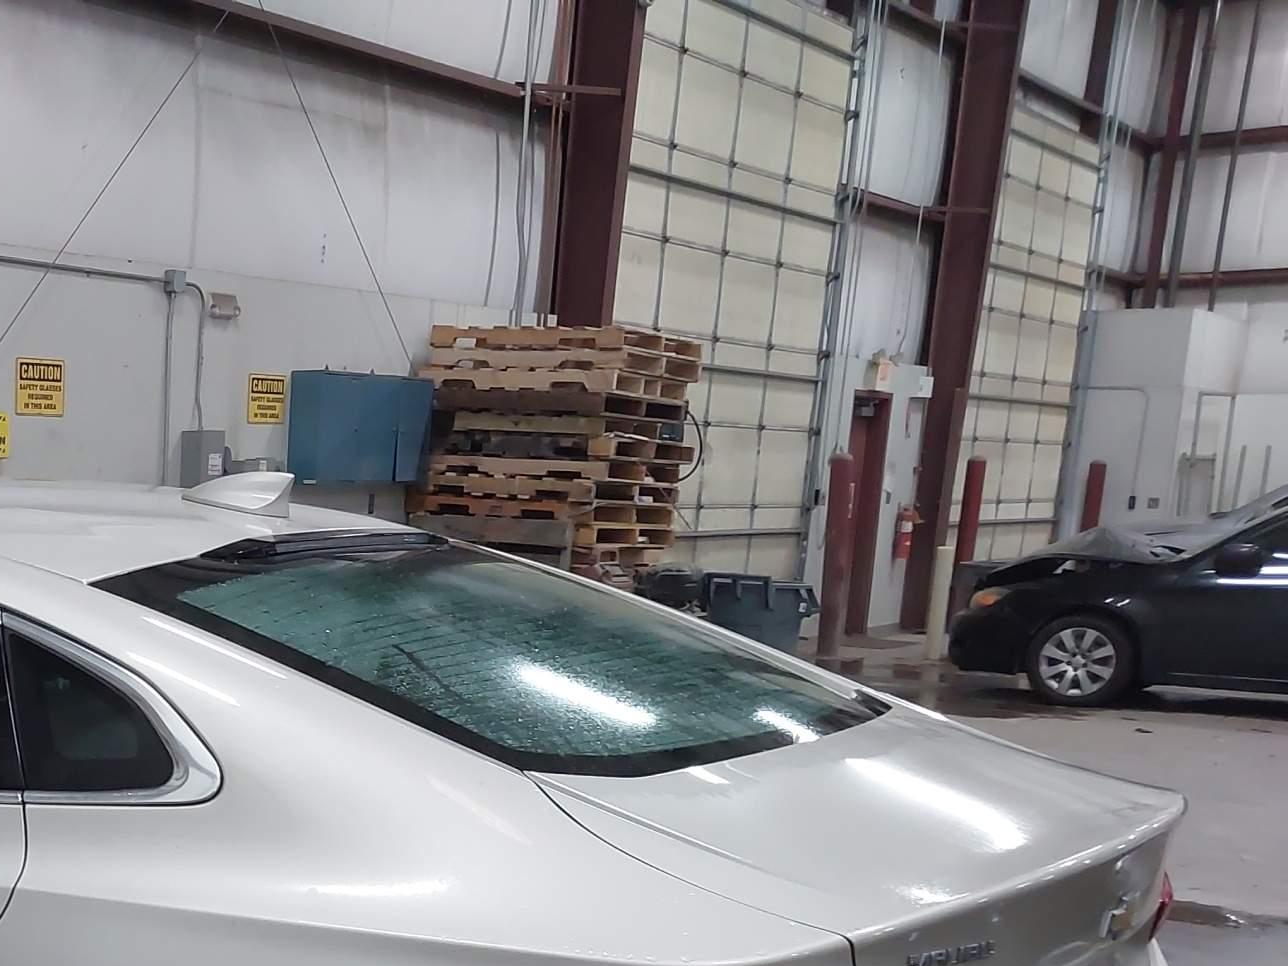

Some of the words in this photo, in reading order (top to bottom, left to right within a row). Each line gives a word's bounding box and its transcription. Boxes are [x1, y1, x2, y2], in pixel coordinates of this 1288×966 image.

[21, 363, 61, 381] CAUTION
[19, 383, 38, 391] SAFETY
[39, 384, 62, 392] GLASSES
[253, 379, 283, 393] CAUTION
[31, 402, 43, 410] THIS
